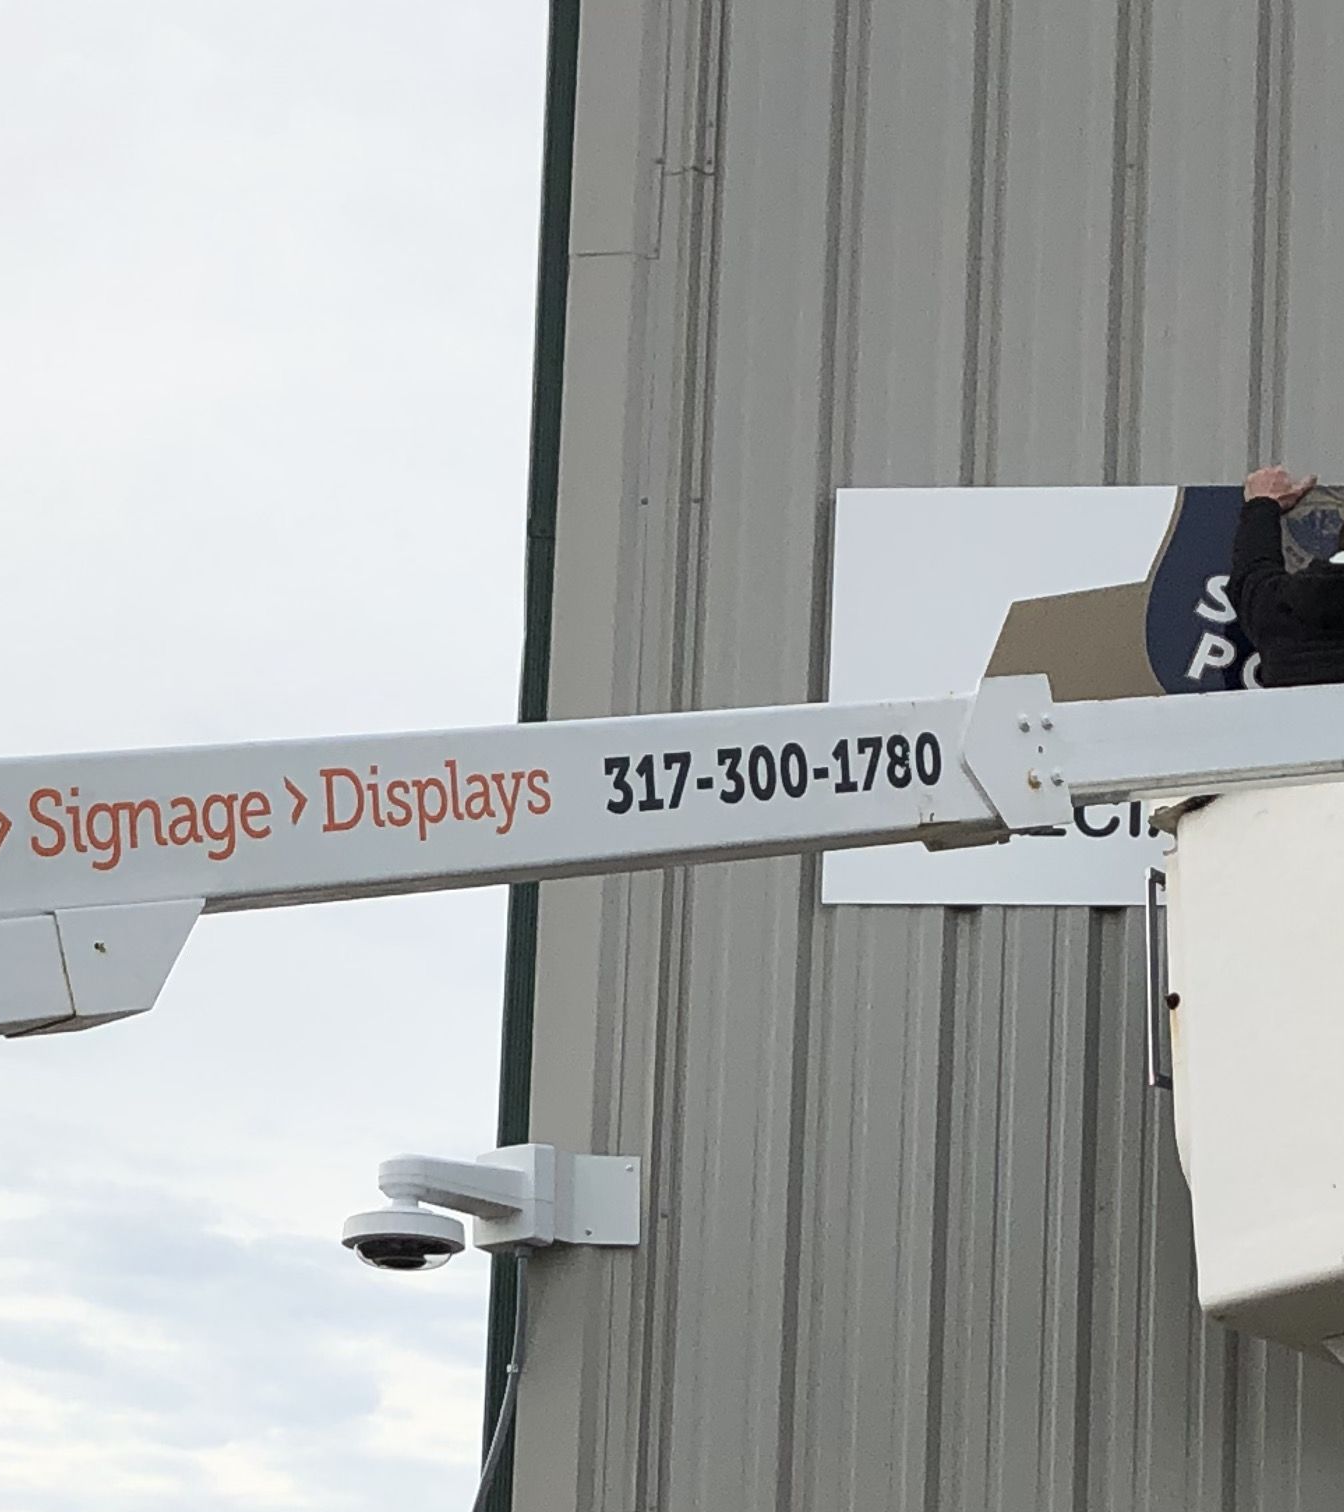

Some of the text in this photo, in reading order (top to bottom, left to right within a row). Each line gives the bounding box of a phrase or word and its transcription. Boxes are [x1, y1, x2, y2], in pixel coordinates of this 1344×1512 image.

[29, 788, 272, 871] Signage
[319, 760, 551, 840] Displays
[604, 731, 942, 815] 317-300-1780
